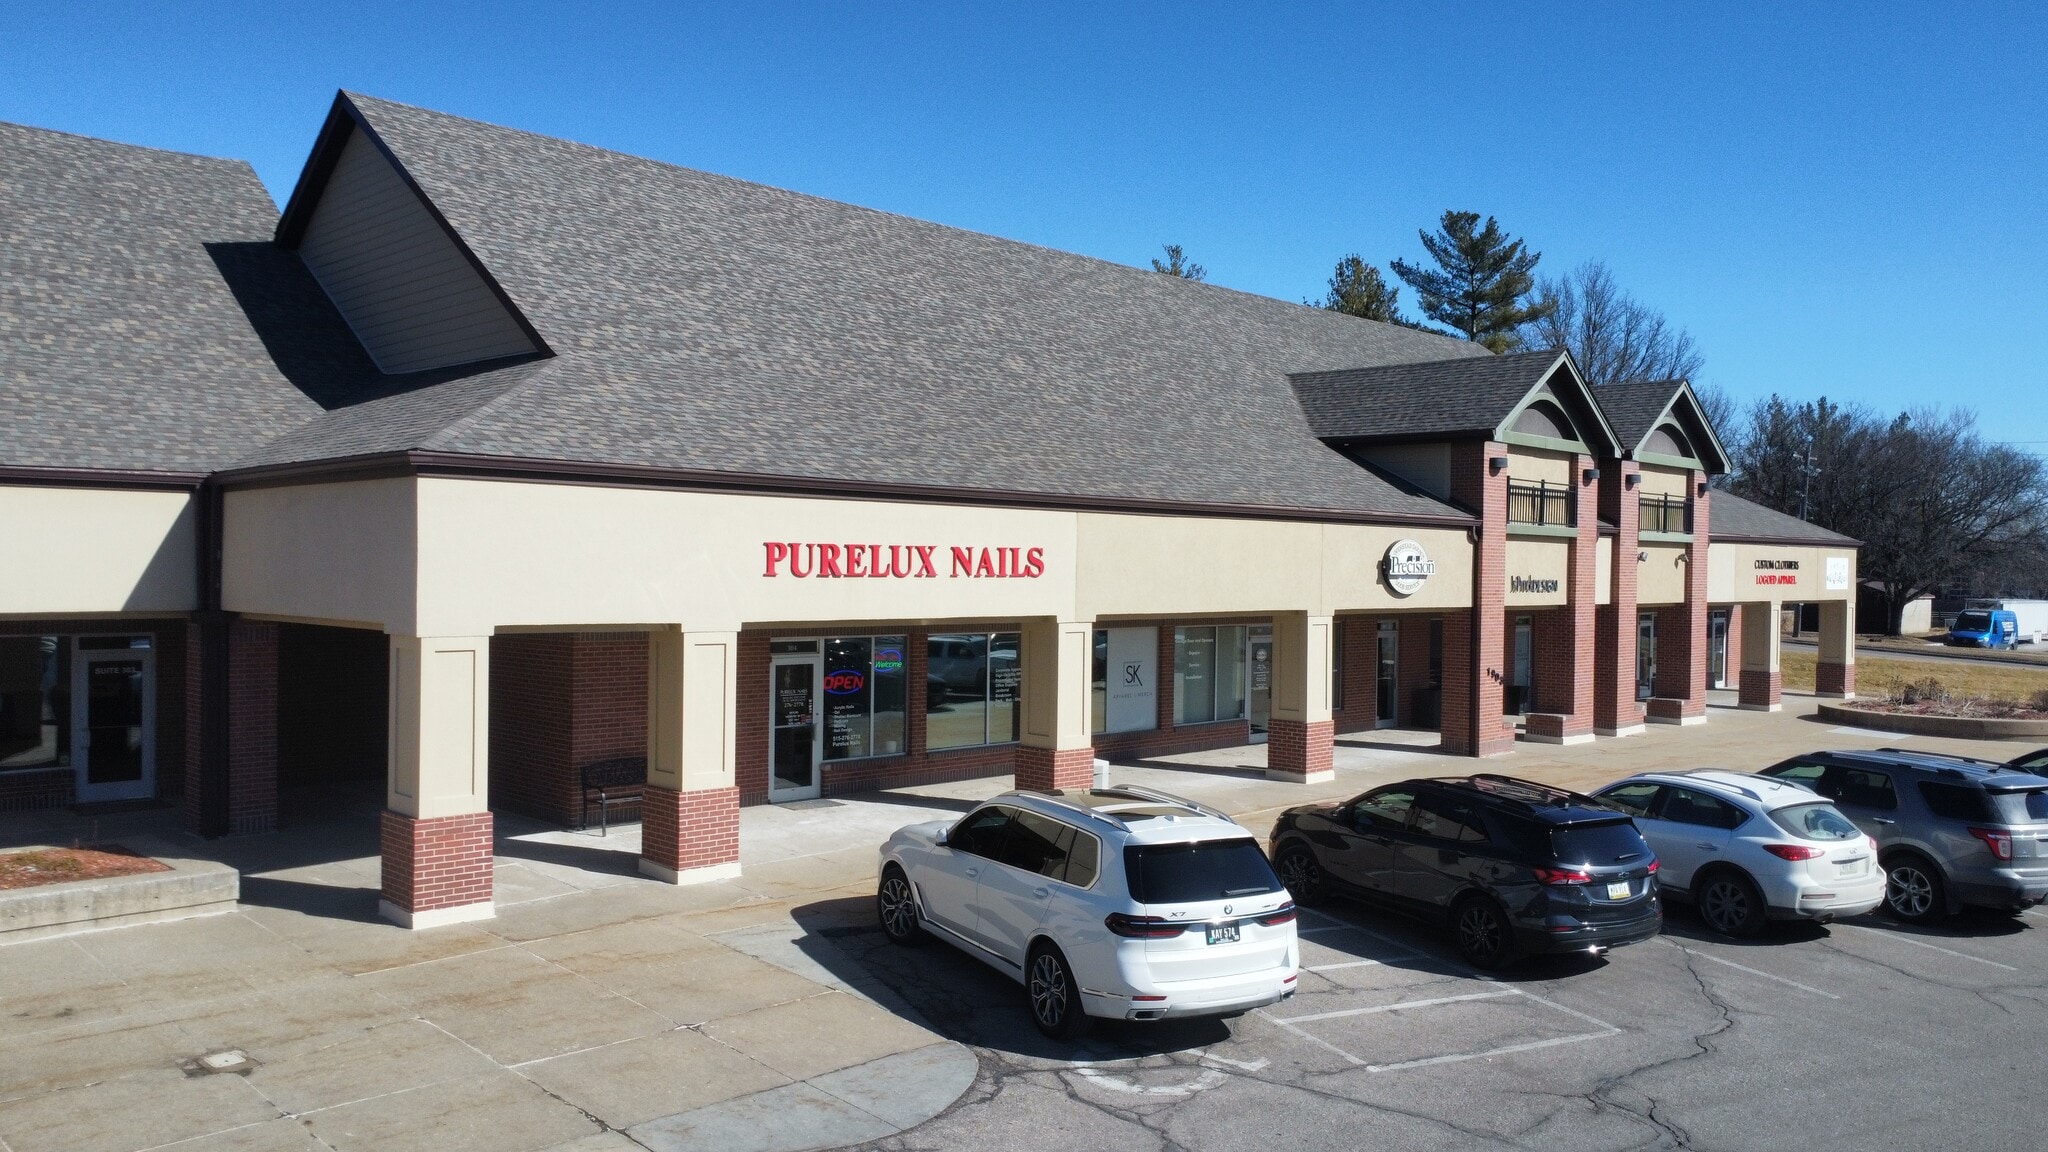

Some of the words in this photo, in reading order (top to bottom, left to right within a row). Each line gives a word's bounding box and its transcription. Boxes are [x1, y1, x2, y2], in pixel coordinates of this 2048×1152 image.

[763, 542, 938, 578] PURELUX
[950, 546, 1045, 578] NAILS
[1391, 556, 1435, 574] Precision
[1754, 560, 1774, 570] CUSTOM
[1777, 575, 1797, 584] APPAREL
[875, 661, 902, 669] Welcome
[1125, 664, 1143, 686] SK
[823, 676, 864, 690] OPEN
